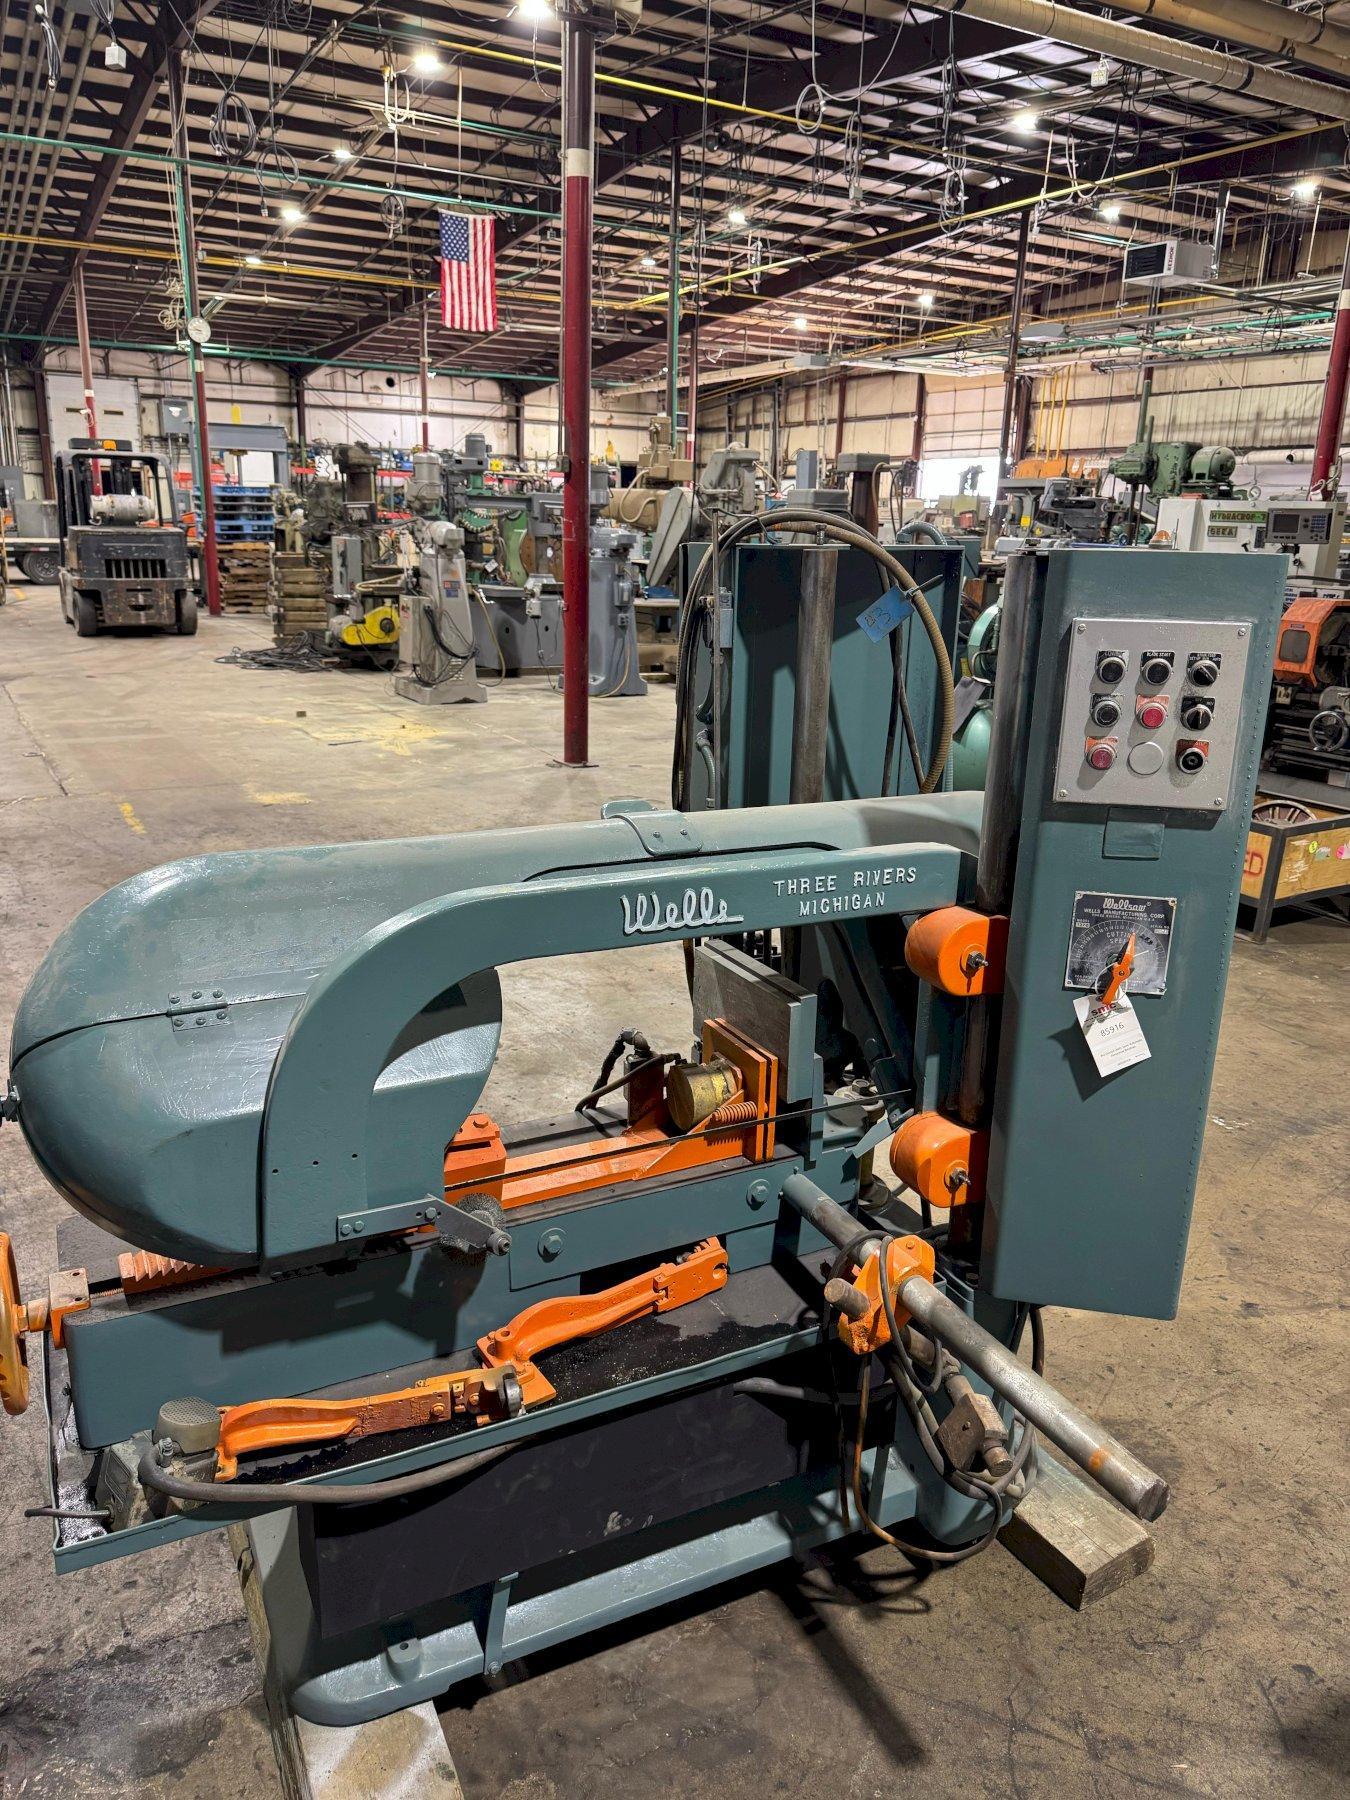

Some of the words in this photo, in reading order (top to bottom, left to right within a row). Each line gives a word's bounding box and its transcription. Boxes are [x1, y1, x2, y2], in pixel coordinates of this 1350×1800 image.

[772, 875, 837, 897] THREE
[853, 867, 917, 888] RIVERS
[620, 887, 744, 936] Wells
[799, 892, 886, 918] MICHIGAN
[1103, 898, 1147, 912] Wellsaw
[1104, 910, 1148, 918] MANUFACTURING
[1100, 1021, 1125, 1038] 85916
